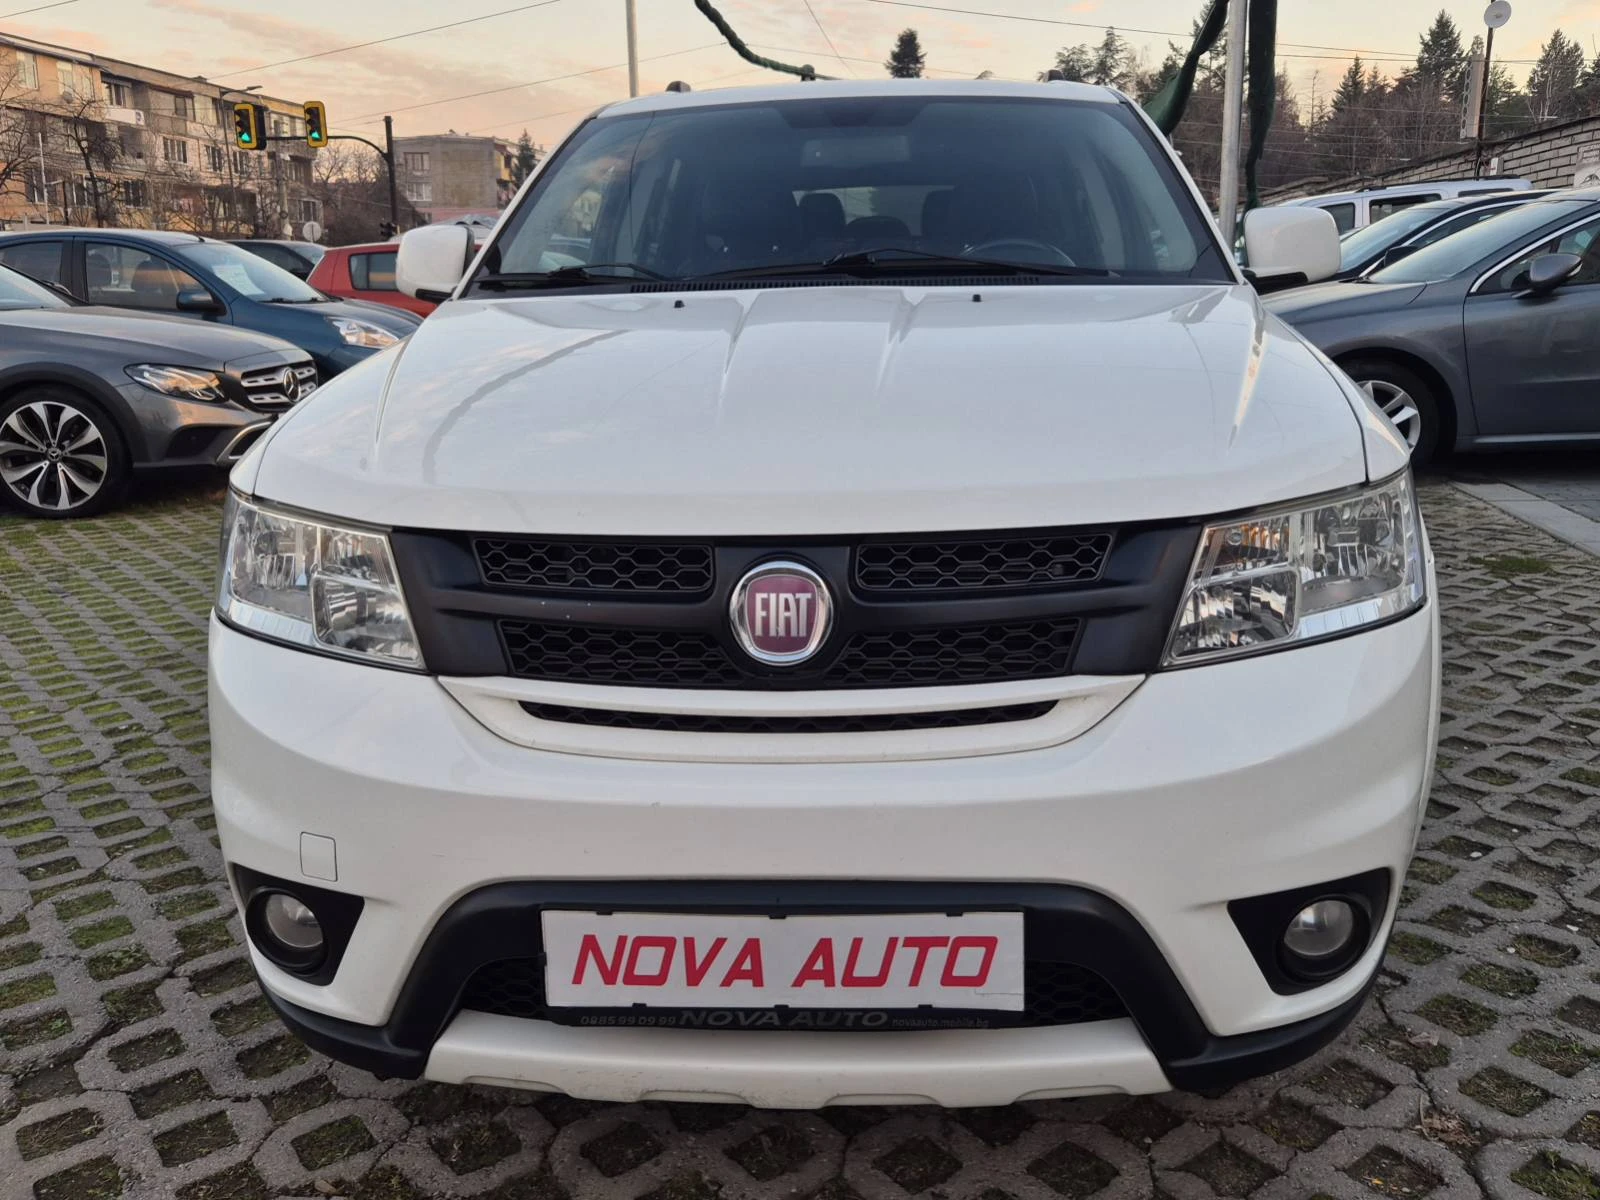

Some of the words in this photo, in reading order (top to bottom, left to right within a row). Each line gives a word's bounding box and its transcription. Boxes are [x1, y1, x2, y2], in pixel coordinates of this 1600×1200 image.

[755, 592, 812, 637] FIAT
[571, 934, 764, 988] NOVA
[791, 935, 998, 988] AUTO
[618, 1015, 635, 1025] 99
[638, 1016, 655, 1025] 09
[659, 1016, 676, 1026] 99
[679, 1010, 781, 1026] NOVA
[788, 1011, 888, 1026] AUTO
